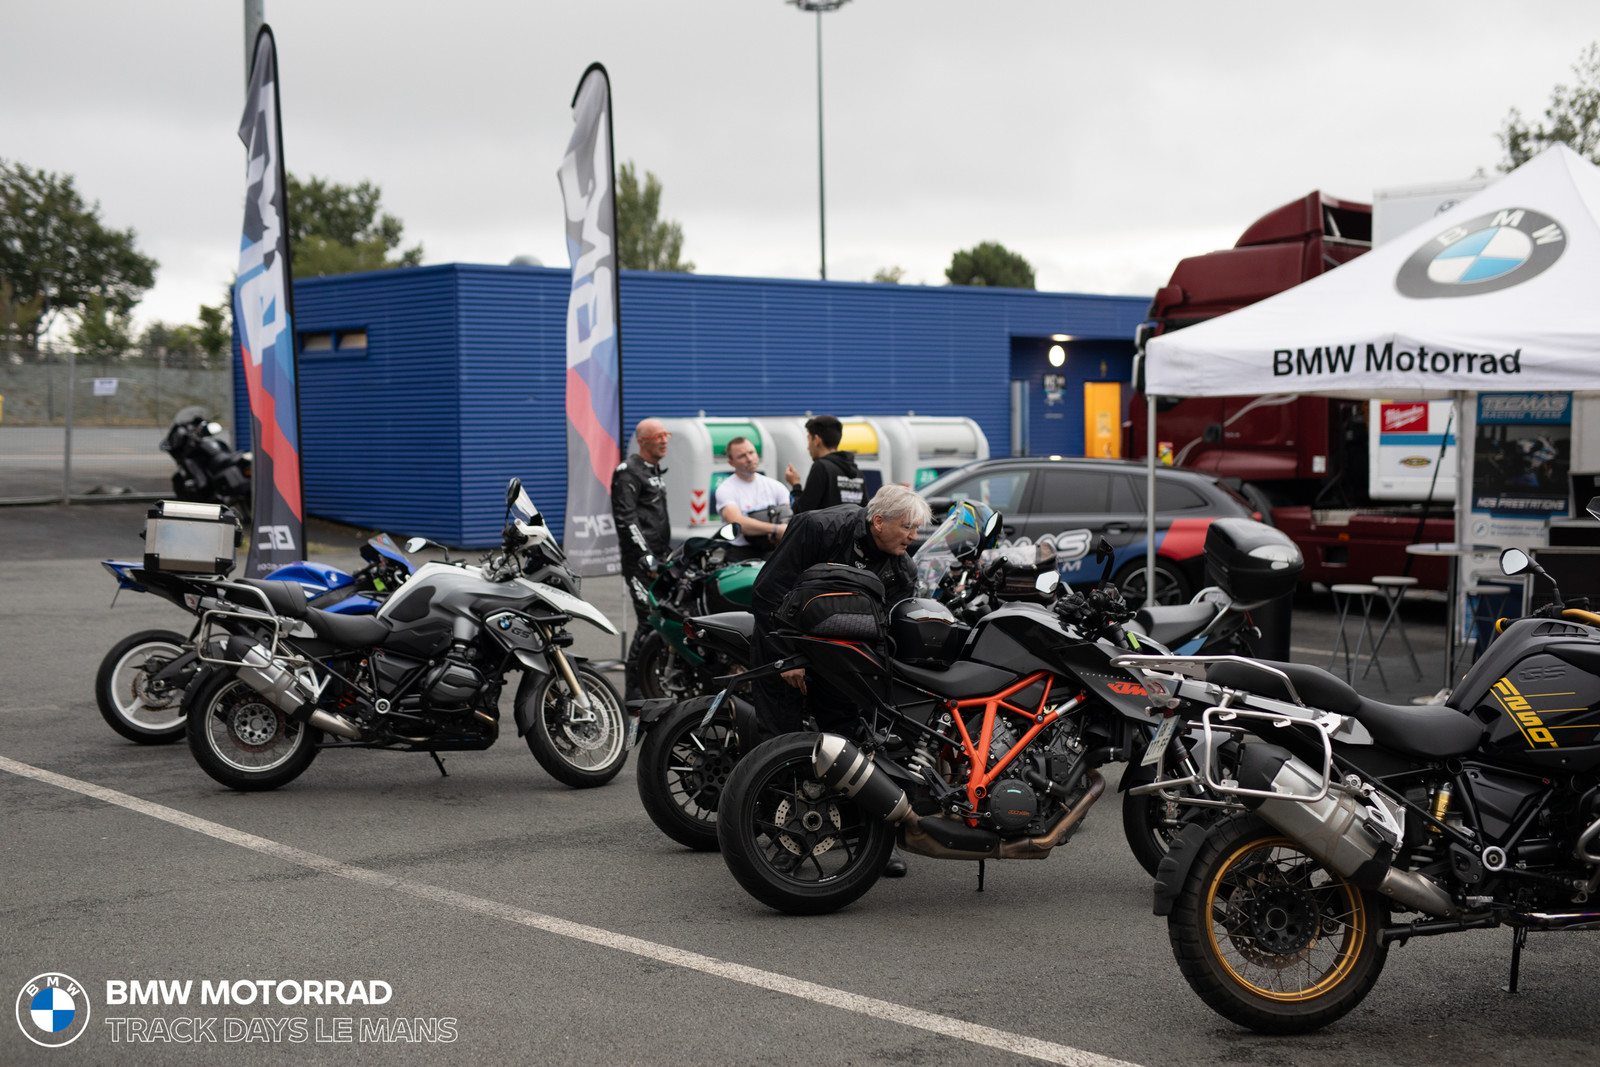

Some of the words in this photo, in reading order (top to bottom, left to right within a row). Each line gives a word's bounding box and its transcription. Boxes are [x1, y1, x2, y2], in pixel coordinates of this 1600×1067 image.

[1437, 209, 1564, 247] BMW
[1273, 344, 1356, 377] BMW
[1365, 342, 1522, 374] Motorrad
[1480, 394, 1569, 412] TECMAS
[511, 627, 532, 639] GS
[1518, 664, 1567, 683] GS
[1107, 681, 1148, 697] KTM
